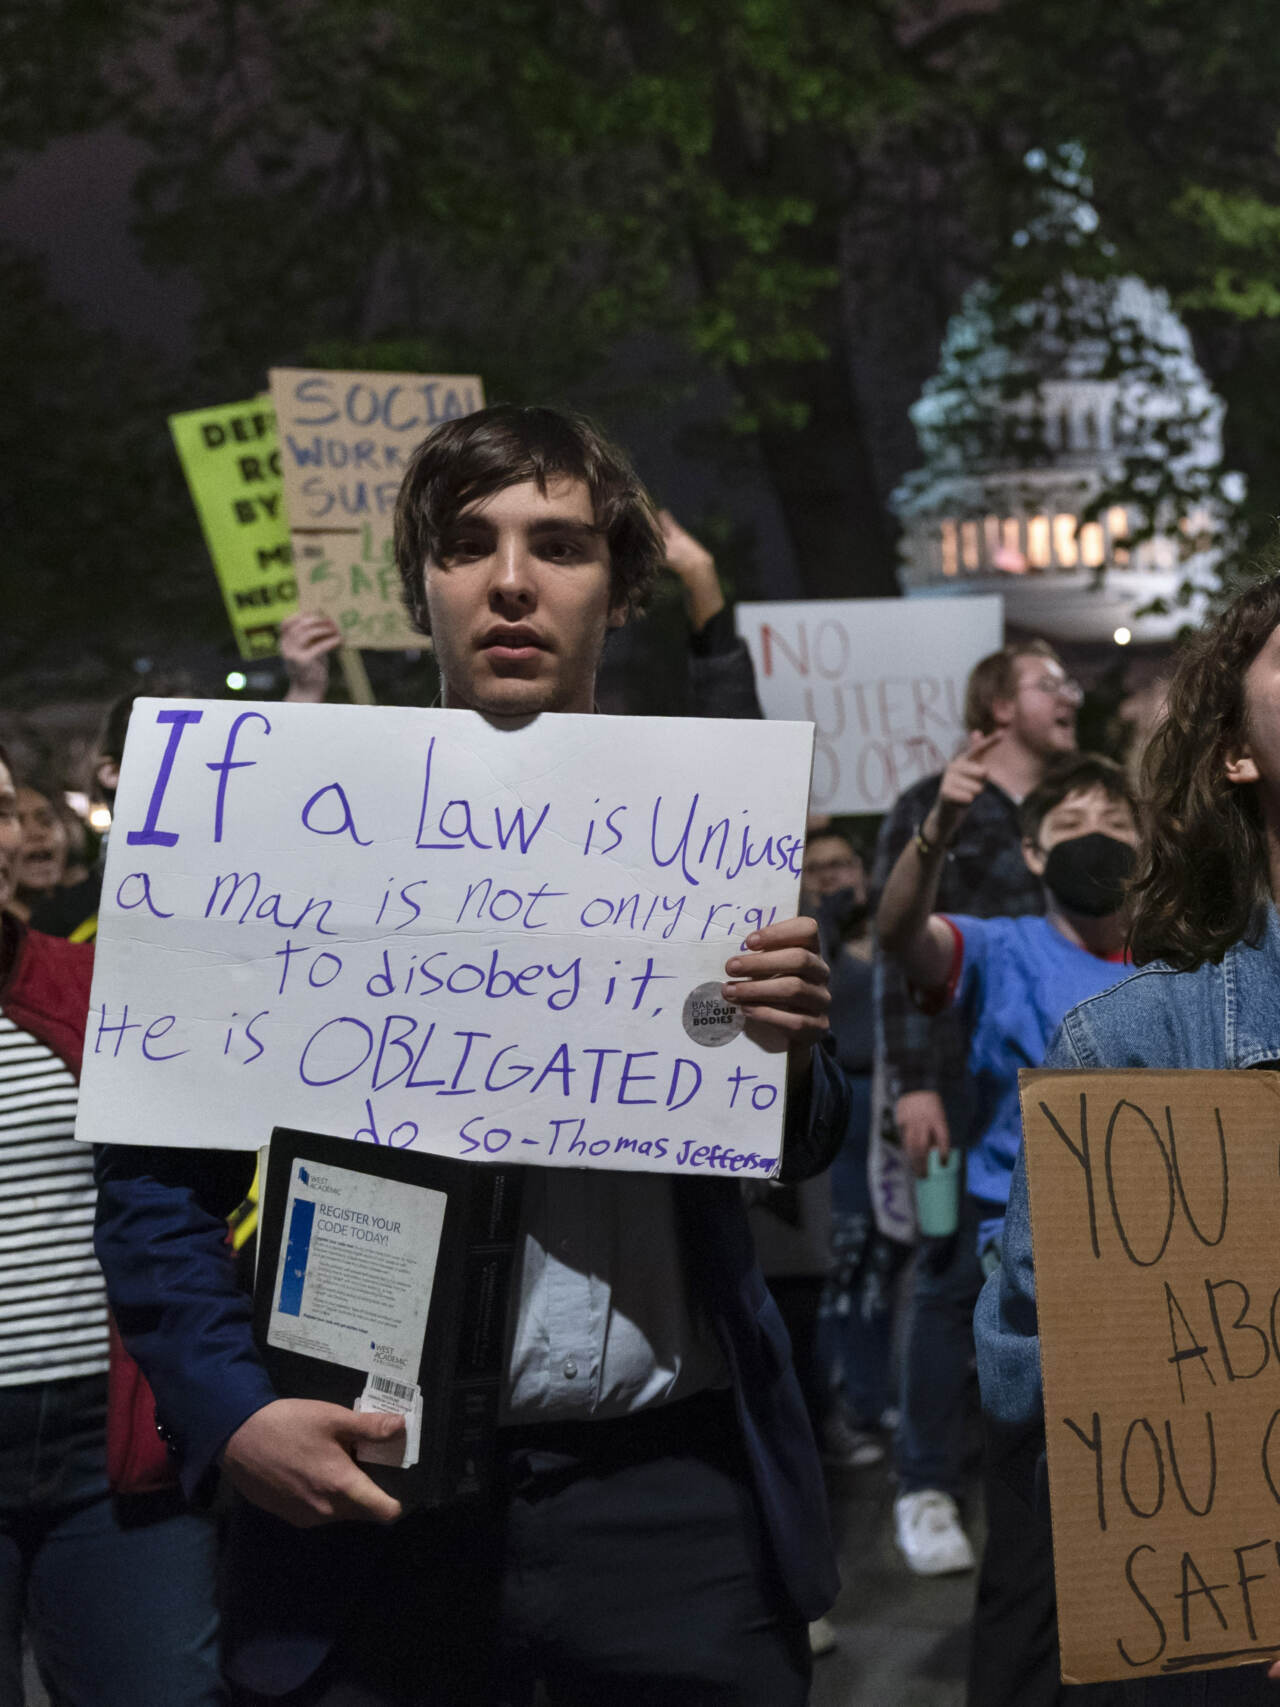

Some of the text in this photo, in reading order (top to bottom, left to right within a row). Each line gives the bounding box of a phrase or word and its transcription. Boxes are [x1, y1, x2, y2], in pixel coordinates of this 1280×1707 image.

[760, 618, 849, 681] NO
[126, 709, 271, 848] If
[302, 783, 373, 846] a
[416, 737, 550, 854] Law
[584, 805, 627, 855] is
[116, 872, 173, 919] a
[376, 880, 426, 924] is
[458, 878, 565, 928] not
[580, 894, 685, 938] only
[276, 940, 342, 994] to
[366, 949, 581, 1011] disobey
[692, 1000, 719, 1009] BANS
[692, 1007, 736, 1018] OFF OUR
[693, 1015, 733, 1026] BODIES
[96, 1005, 777, 1111] He is OBLIGATED to
[354, 1099, 418, 1149] do
[1039, 1093, 1228, 1267] YOU
[317, 1219, 389, 1247] CODE TODAY!
[320, 1203, 401, 1234] REGISTER YOUR
[1063, 1412, 1216, 1531] YOU
